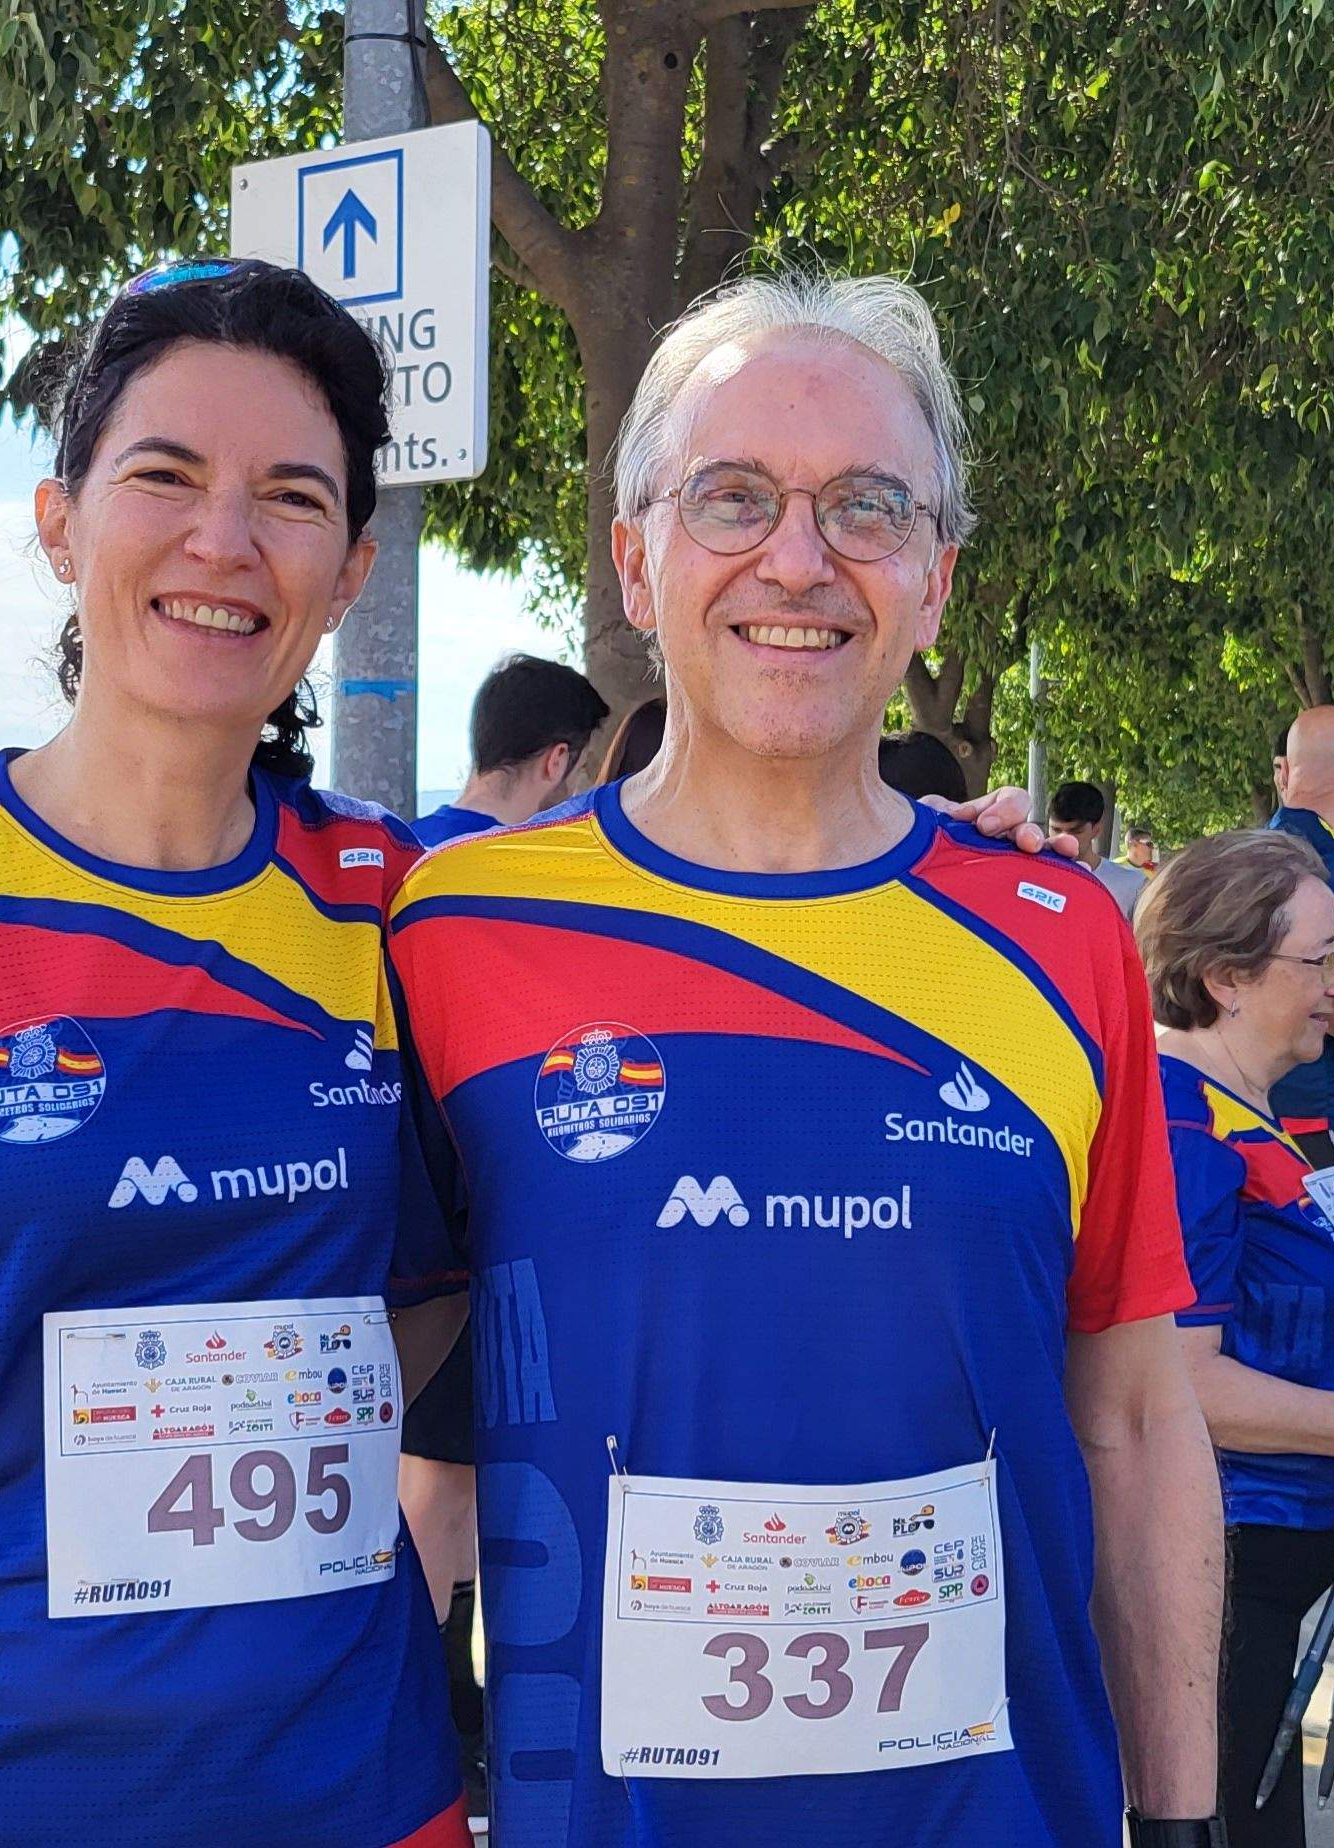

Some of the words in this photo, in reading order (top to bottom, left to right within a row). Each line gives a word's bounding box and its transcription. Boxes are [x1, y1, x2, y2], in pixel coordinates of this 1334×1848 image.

[343, 852, 382, 863] 42K
[52, 1080, 102, 1099] 091
[309, 1080, 402, 1108] Santande
[38, 1097, 95, 1113] SOLIDARIOS
[541, 1101, 602, 1126] RUTA
[613, 1094, 659, 1113] 091
[599, 1113, 651, 1128] SOLIDARIOS
[884, 1112, 1035, 1158] Santander
[210, 1148, 349, 1202] mupol
[766, 1185, 912, 1238] mupol
[185, 1350, 247, 1364] Santander
[352, 1364, 375, 1376] CEP
[165, 1378, 186, 1386] CAJA
[188, 1376, 217, 1385] RURAL
[169, 1406, 190, 1414] Cruz
[192, 1404, 212, 1413] Roja
[147, 1443, 352, 1547] 495
[742, 1532, 807, 1545] Santander
[933, 1540, 965, 1554] CEP
[721, 1555, 742, 1564] CAJA
[744, 1556, 774, 1565] RURAL
[724, 1583, 745, 1591] Cruz
[747, 1583, 768, 1592] Roja
[849, 1575, 891, 1588] eboca
[74, 1580, 172, 1604] #RUTA091
[701, 1622, 930, 1722] 337
[937, 1734, 996, 1752] NACIONAL
[625, 1746, 720, 1766] #RUTA091
